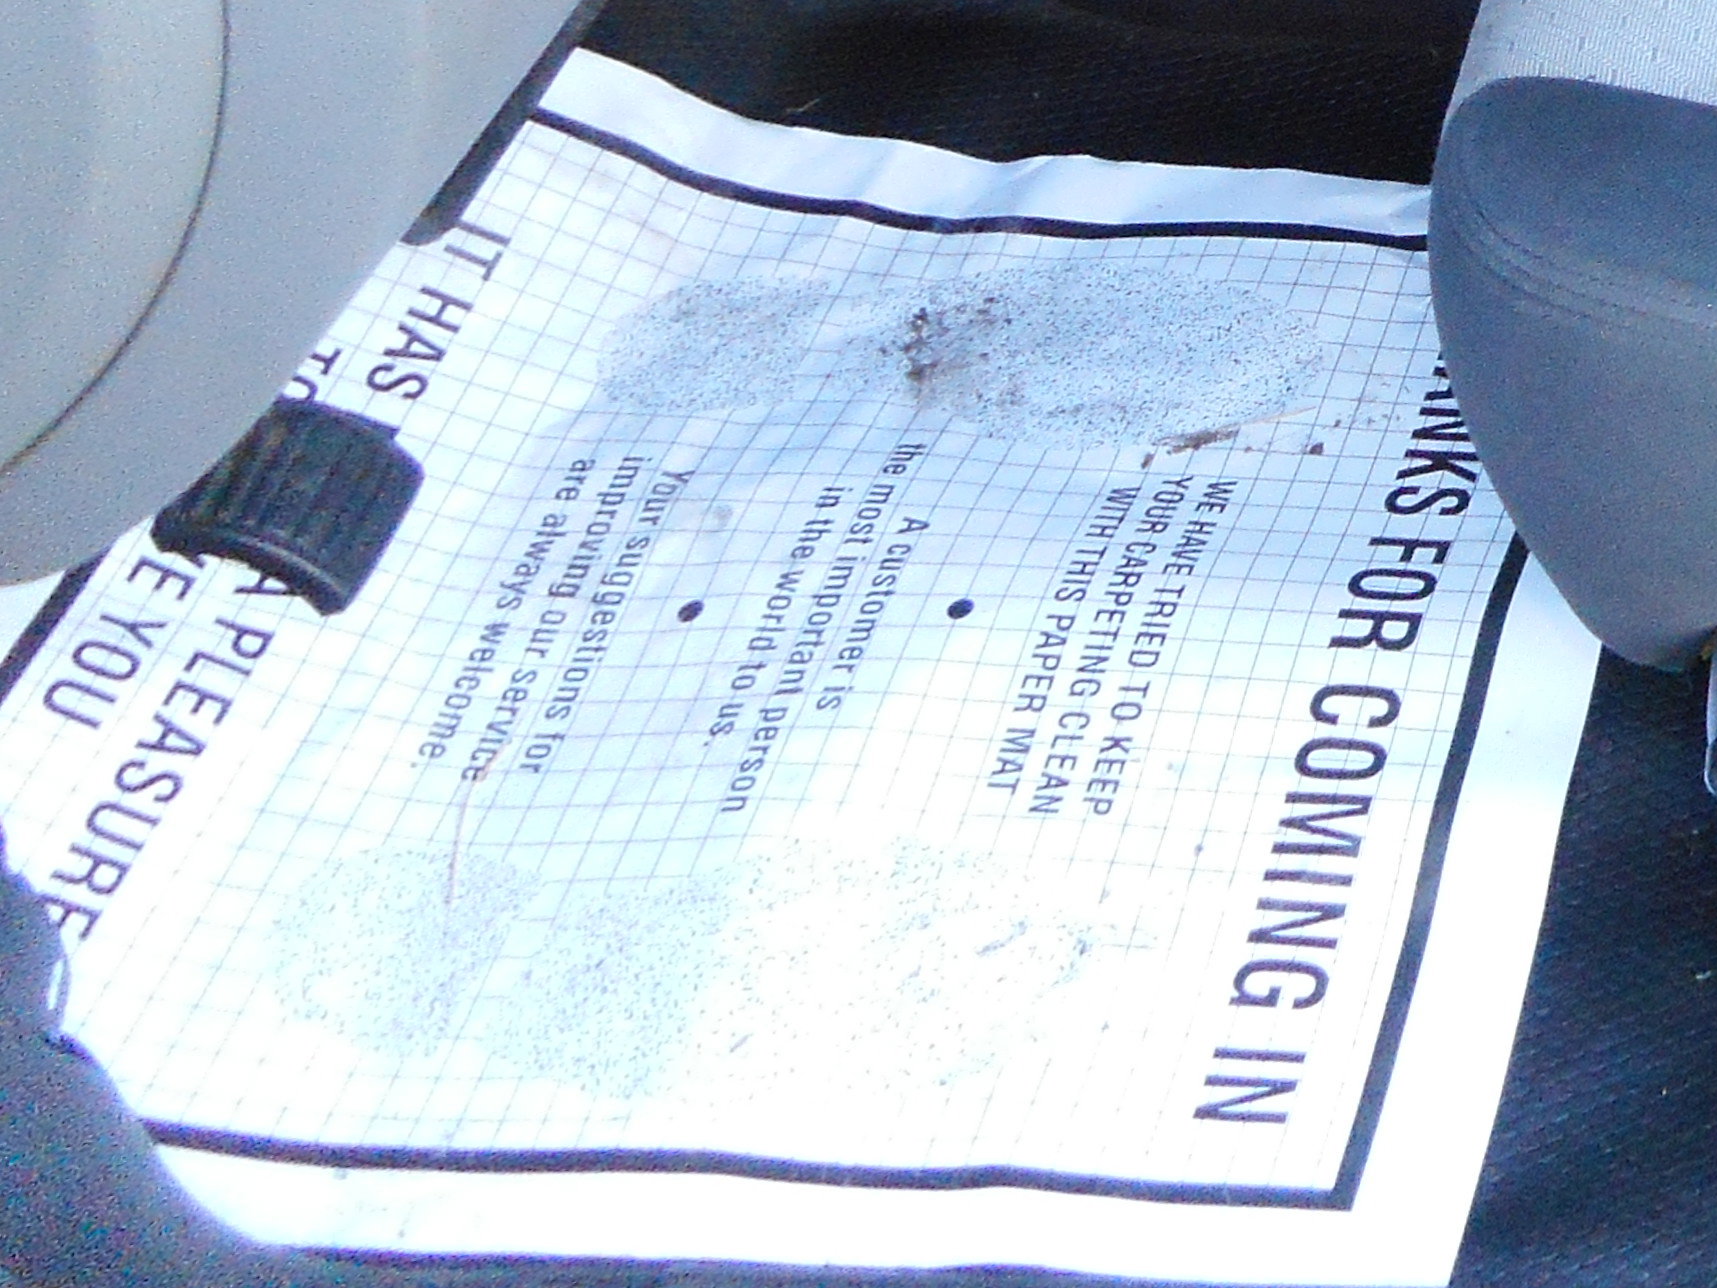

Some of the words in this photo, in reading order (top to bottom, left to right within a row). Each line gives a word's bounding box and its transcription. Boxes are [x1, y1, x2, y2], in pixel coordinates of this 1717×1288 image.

[443, 220, 509, 281] IT
[366, 286, 474, 401] HAS
[555, 459, 596, 502] are
[883, 443, 926, 477] the
[549, 456, 651, 599] improving
[646, 468, 696, 527] Your
[820, 486, 854, 508] in
[847, 485, 894, 548] most
[901, 516, 930, 534] A
[1084, 485, 1142, 537] WITH
[1134, 475, 1193, 534] YOUR
[1194, 480, 1238, 515] WE
[496, 513, 566, 611] always
[791, 516, 833, 558] the
[1162, 521, 1217, 577] HAVE
[1054, 547, 1107, 602] THIS
[1327, 536, 1450, 651] FOR
[524, 610, 567, 659] our
[544, 536, 651, 721] suggestions
[746, 569, 802, 652] world
[779, 559, 855, 696] important
[833, 543, 912, 674] customer
[1067, 541, 1157, 698] CARPETING
[1127, 584, 1184, 668] TRIED
[43, 615, 168, 731] YOU
[411, 622, 508, 768] welcome.
[729, 660, 766, 690] to
[1013, 613, 1076, 713] PAPER
[461, 668, 537, 782] service
[702, 702, 743, 747] us.
[816, 685, 855, 711] is
[1110, 680, 1151, 721] TO
[519, 732, 566, 774] for
[720, 706, 788, 813] person
[987, 728, 1036, 794] MAT
[1028, 711, 1090, 814] CLEAN
[1083, 735, 1133, 815] KEEP
[1229, 684, 1401, 1009] COMING
[1193, 1047, 1306, 1123] IN
